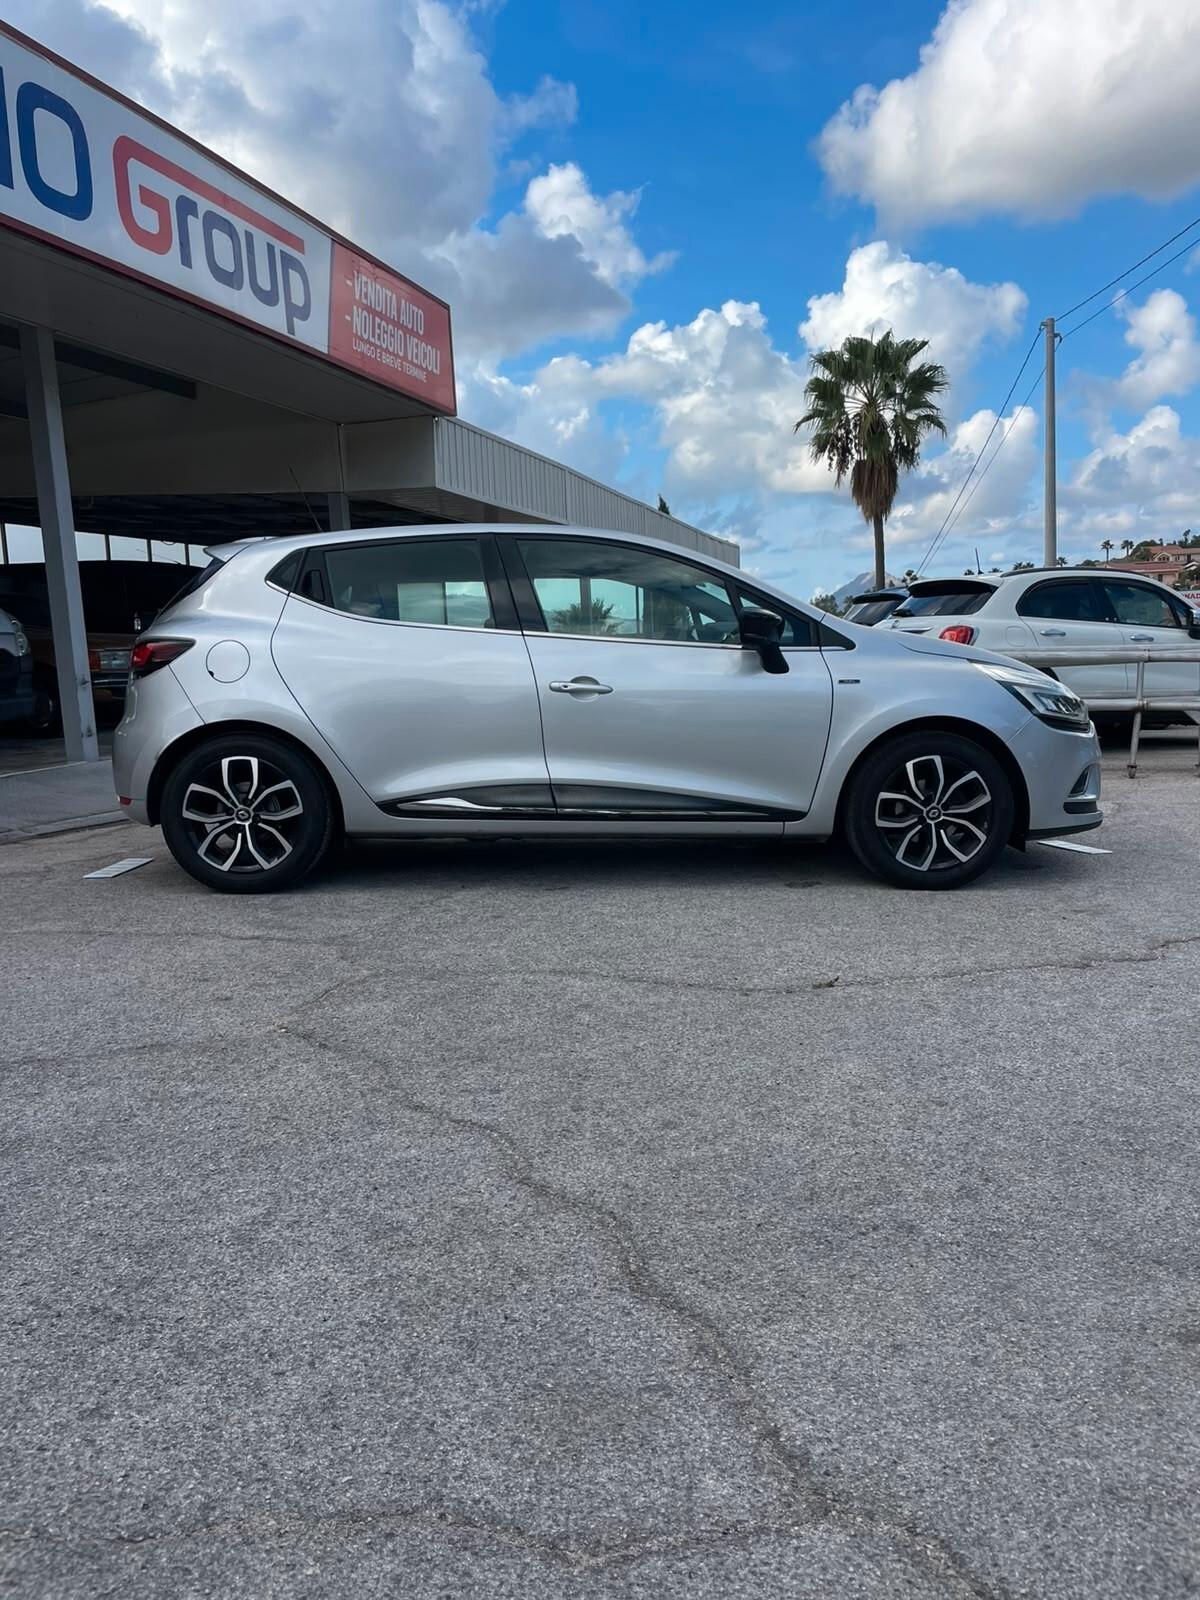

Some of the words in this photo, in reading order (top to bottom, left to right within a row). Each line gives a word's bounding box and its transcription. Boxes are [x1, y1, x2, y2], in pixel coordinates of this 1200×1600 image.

[112, 135, 312, 336] Group
[400, 299, 424, 336] AUTO
[352, 337, 376, 359] LUNGO
[376, 348, 381, 361] E
[382, 352, 402, 371] BREVE
[402, 361, 428, 383] TERMINE
[406, 333, 440, 375] VEICOLI
